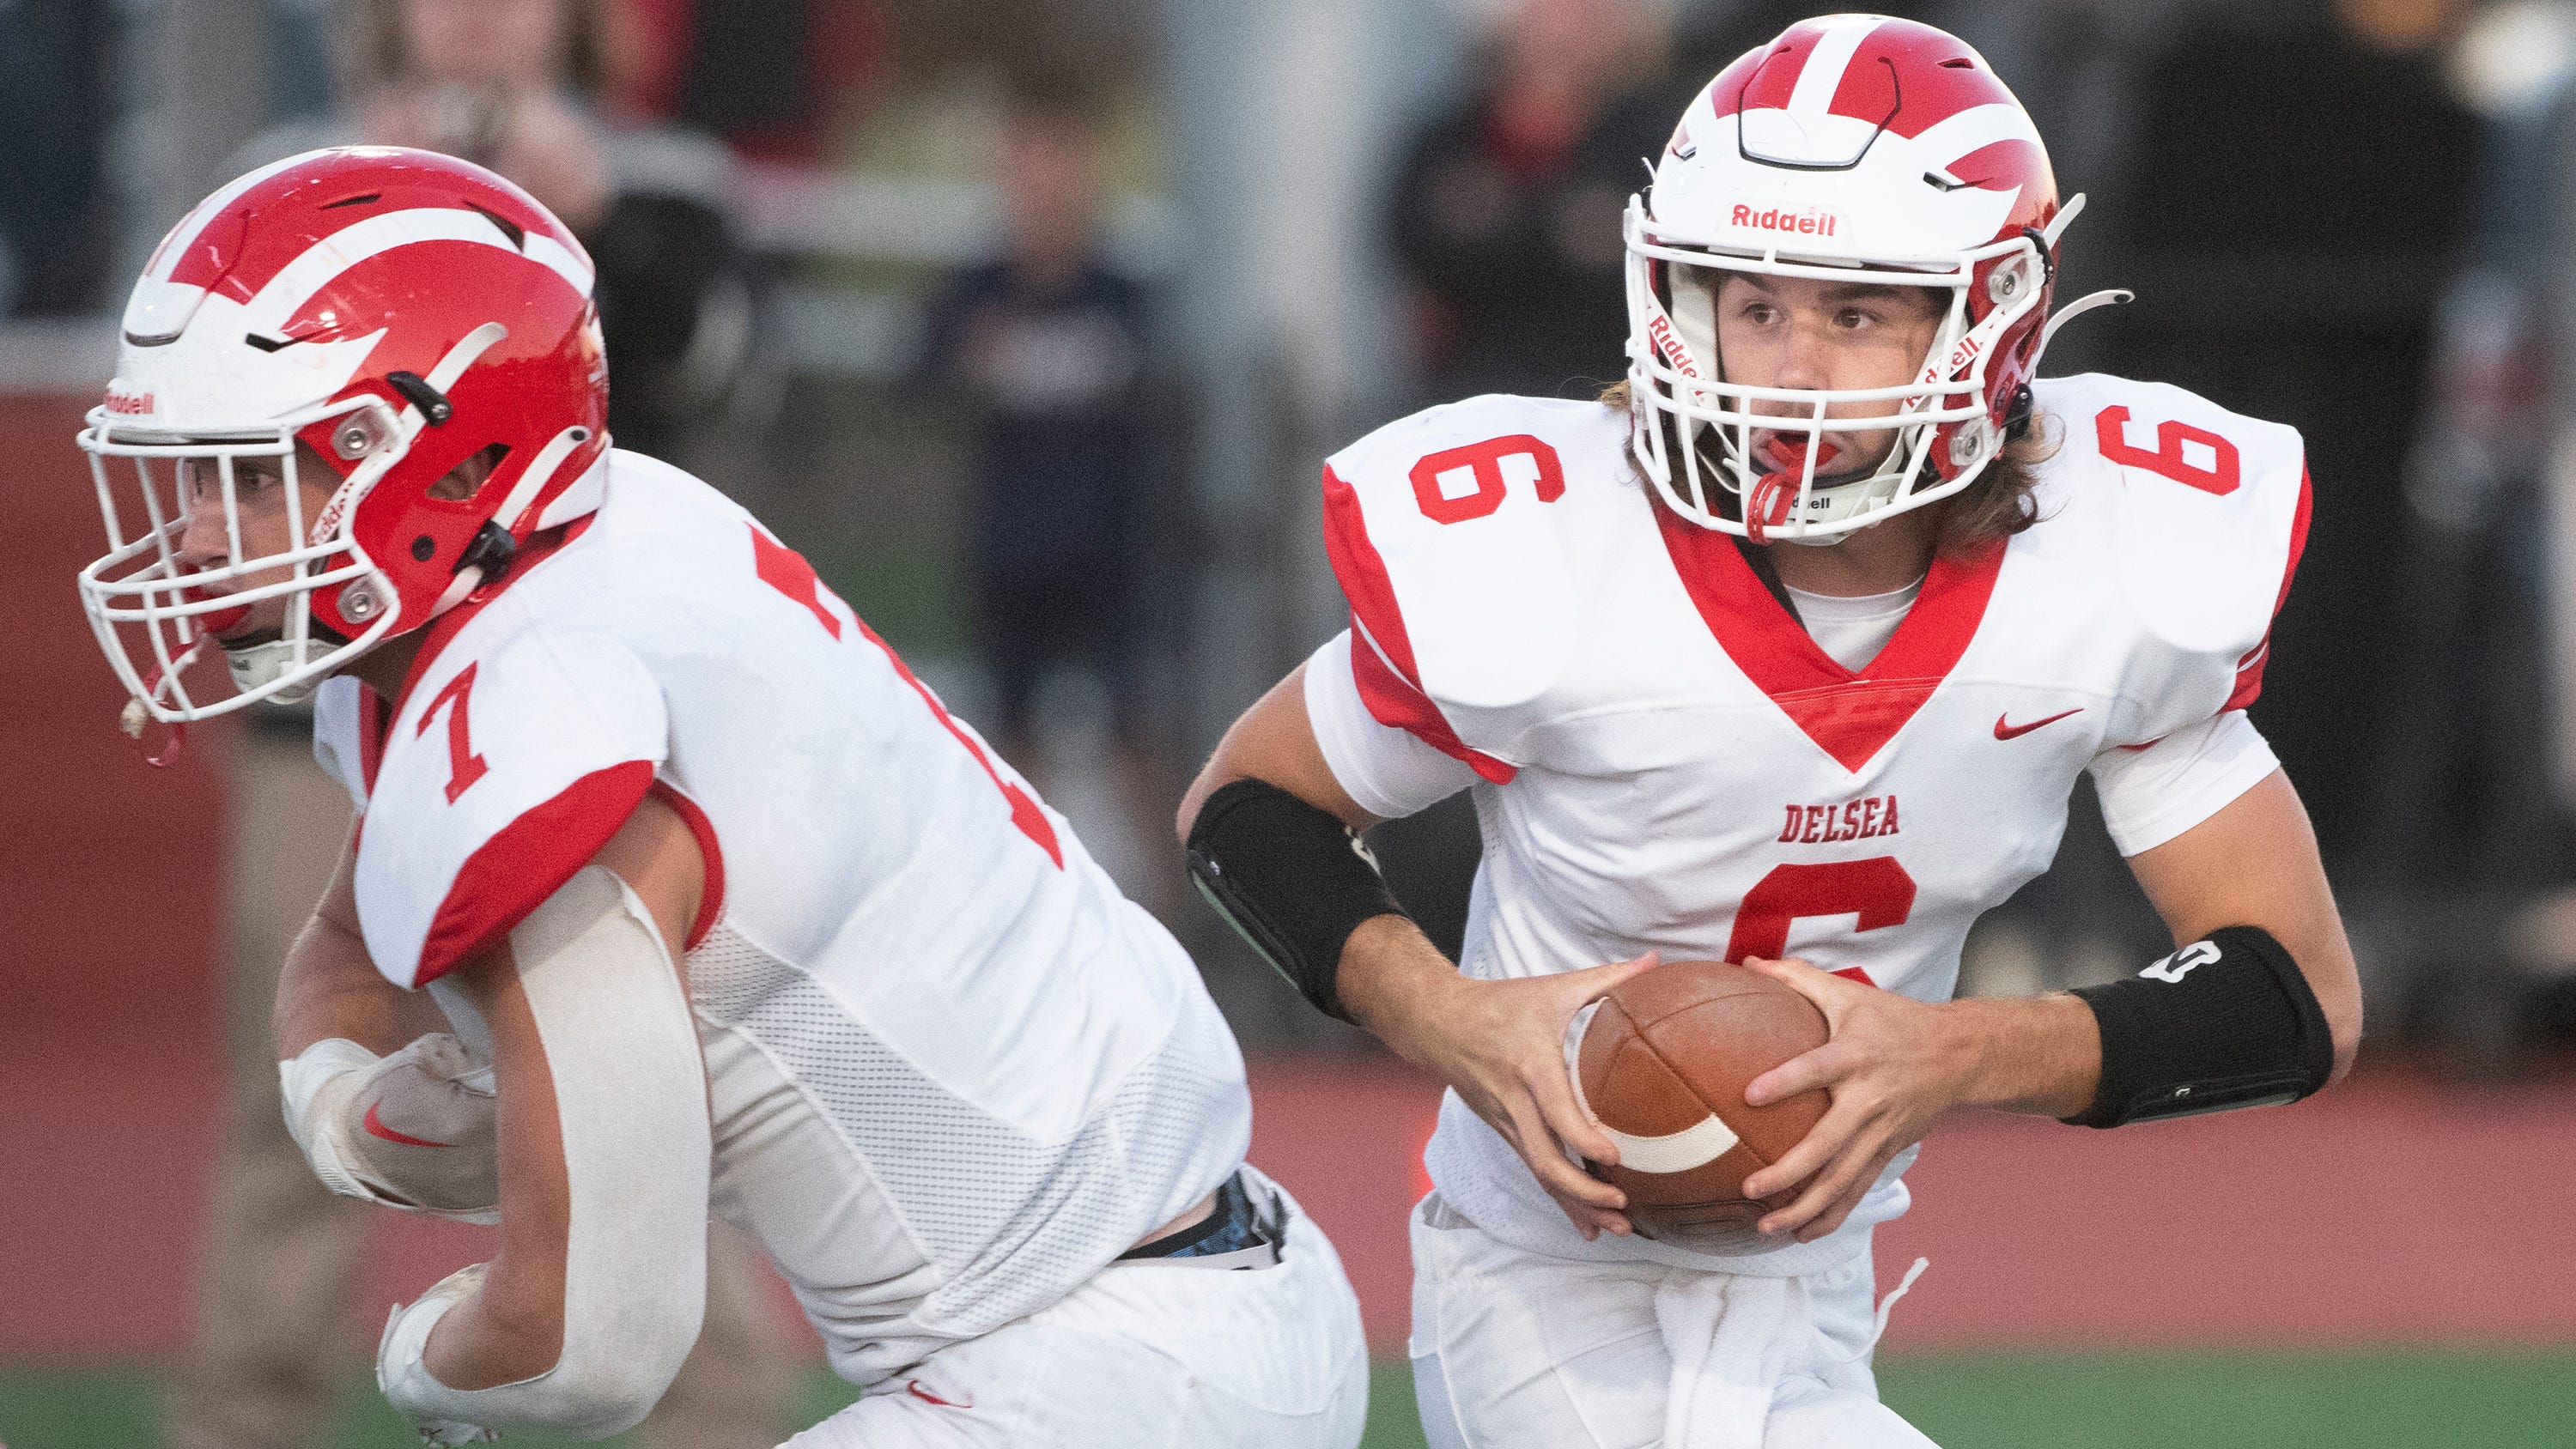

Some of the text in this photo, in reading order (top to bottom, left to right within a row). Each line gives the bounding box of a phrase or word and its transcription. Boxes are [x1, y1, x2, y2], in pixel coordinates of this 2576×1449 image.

[1732, 204, 1837, 236] Riddell
[1408, 433, 1566, 525] 6
[2095, 404, 2240, 496] 6
[415, 659, 490, 806] 7
[1777, 795, 1899, 844] DELSEA
